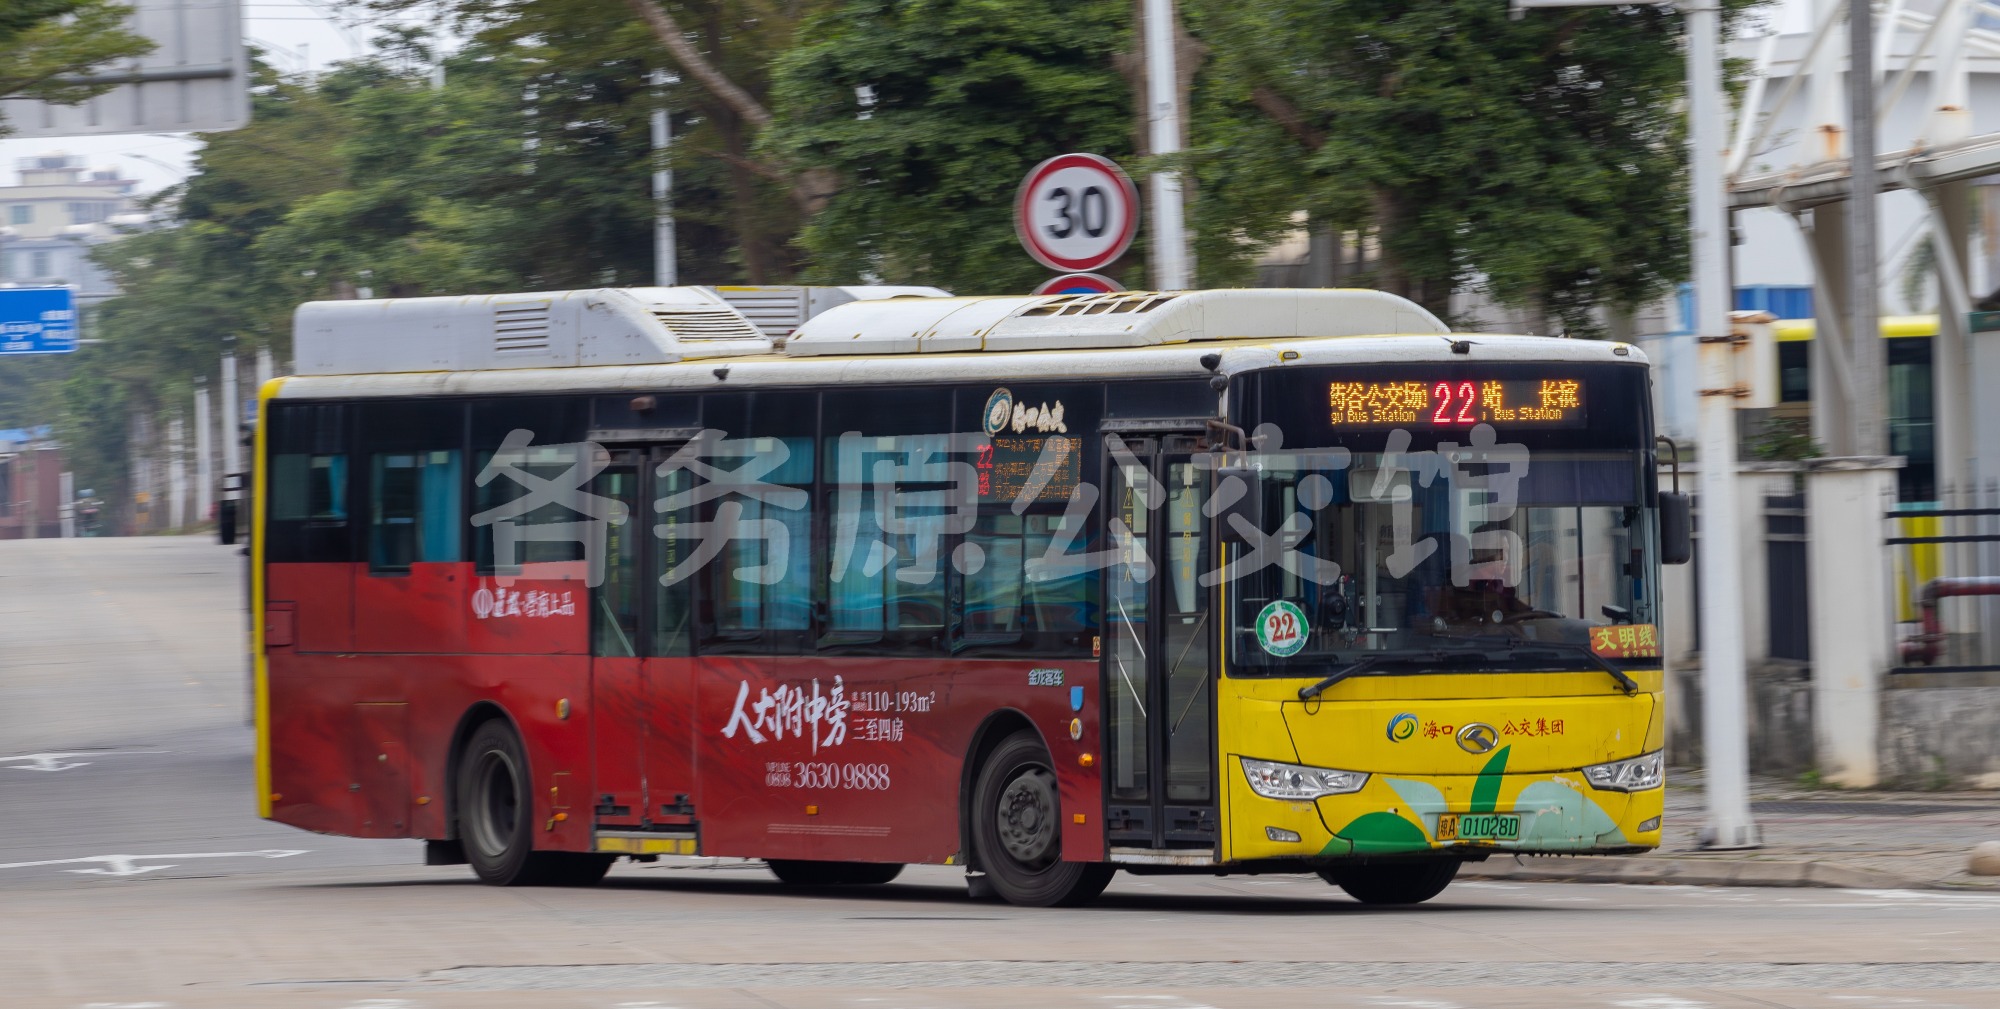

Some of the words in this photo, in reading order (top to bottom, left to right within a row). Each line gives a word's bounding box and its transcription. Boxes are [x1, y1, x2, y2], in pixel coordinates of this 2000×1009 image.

[1045, 186, 1107, 239] 30
[1433, 382, 1475, 423] 22
[1494, 408, 1515, 420] Bus
[1519, 407, 1562, 420] Station
[1348, 410, 1368, 422] Bus
[1372, 409, 1416, 422] Station
[977, 444, 994, 468] 22
[1268, 612, 1297, 643] 22
[1596, 625, 1657, 651] 文明线
[1028, 668, 1063, 686] 金龙客车
[721, 674, 851, 757] 人大附中旁
[852, 717, 904, 742] 三至四房
[1423, 719, 1454, 740] 海口
[1501, 717, 1565, 738] 公交集团
[765, 772, 792, 788] 0898
[794, 761, 840, 789] 3630
[842, 762, 891, 791] 9888
[1462, 816, 1519, 837] 01028D
